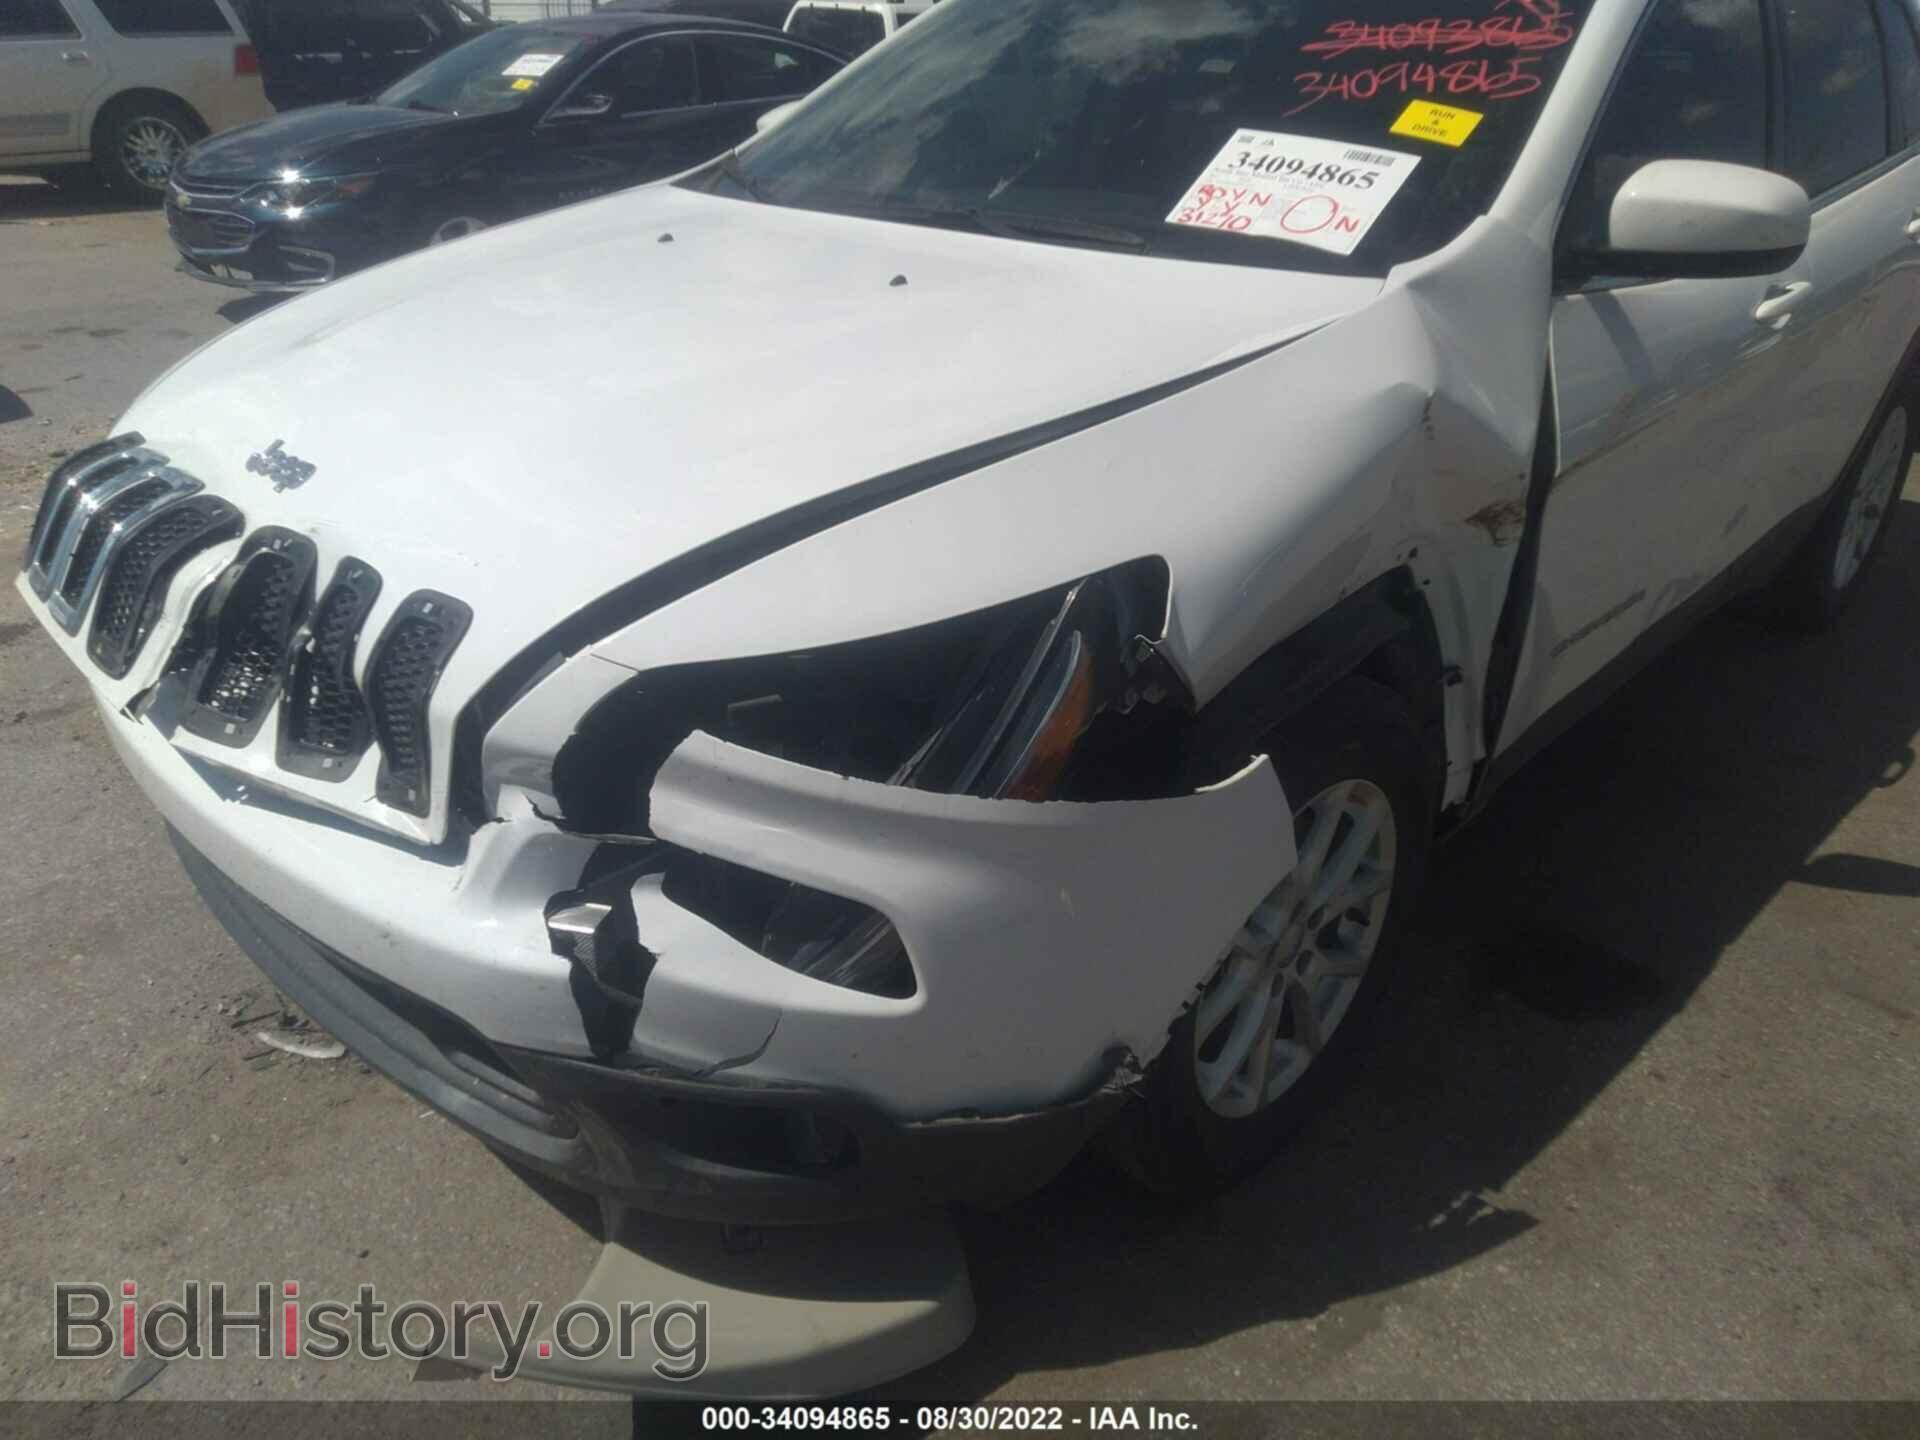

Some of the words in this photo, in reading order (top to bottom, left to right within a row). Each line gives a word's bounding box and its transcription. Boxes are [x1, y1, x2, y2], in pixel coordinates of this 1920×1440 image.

[1282, 57, 1543, 118] 34094865
[1430, 108, 1456, 120] RUN
[1411, 124, 1448, 137] DRIVE
[1227, 150, 1380, 190] 34094865
